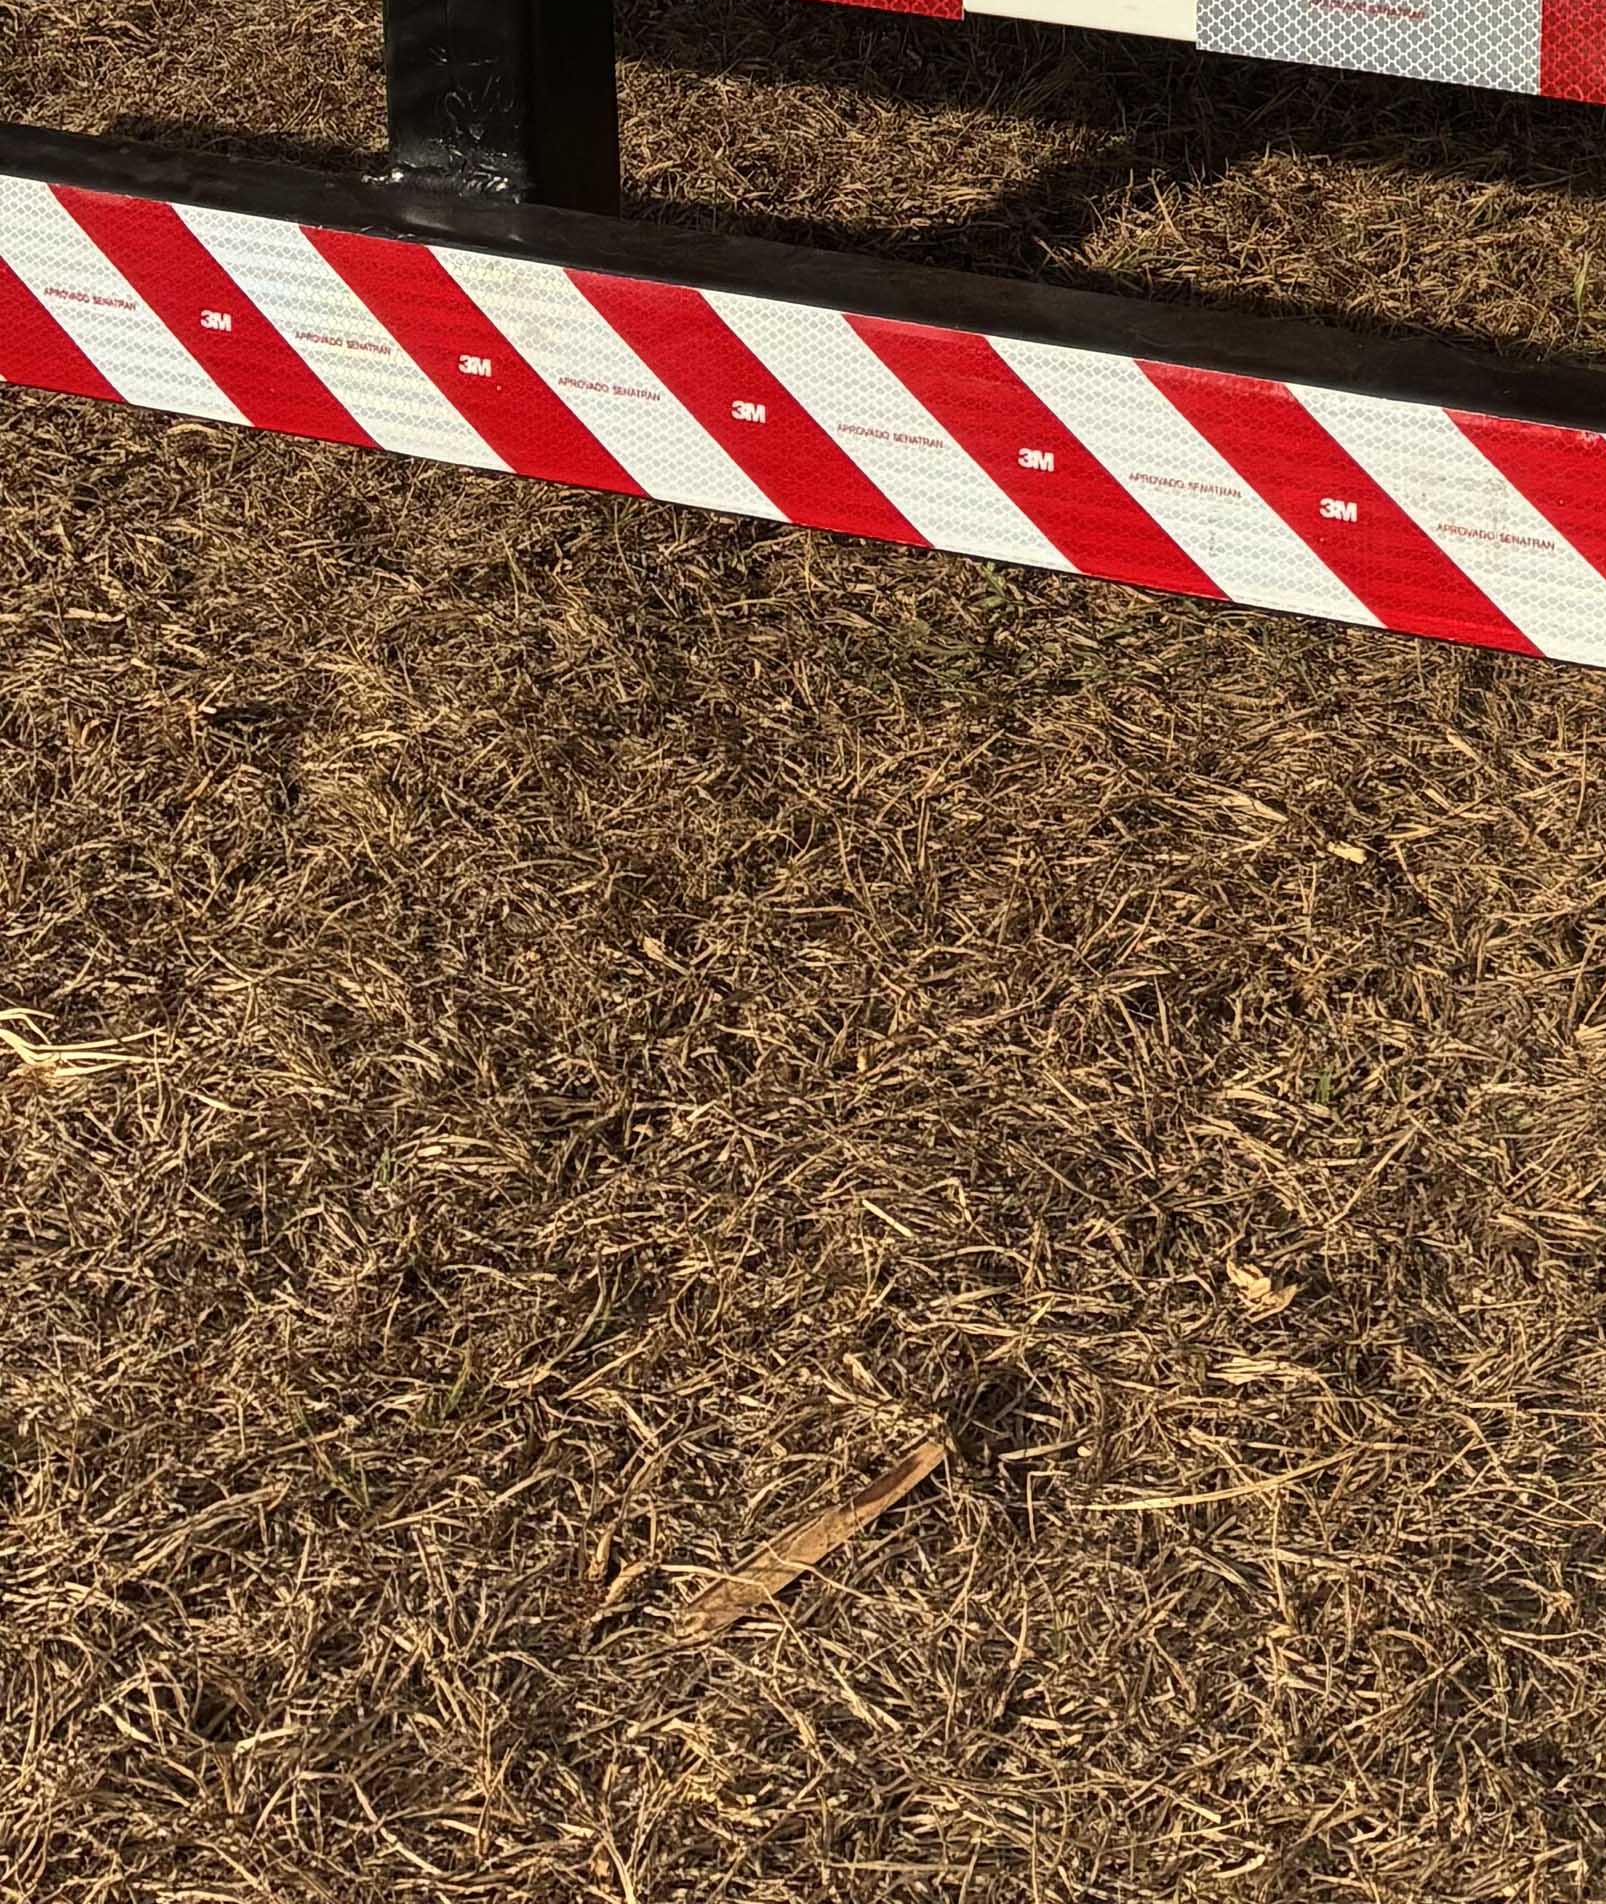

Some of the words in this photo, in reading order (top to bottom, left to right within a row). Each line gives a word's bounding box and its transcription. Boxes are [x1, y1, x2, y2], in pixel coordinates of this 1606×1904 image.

[200, 309, 232, 332] 3M
[458, 354, 492, 377] 3M
[731, 400, 766, 423] 3M
[837, 423, 890, 441] APROVADO
[1017, 448, 1055, 472] 3M
[1129, 472, 1184, 489] APROVADO
[1319, 498, 1357, 522] 3M
[1436, 523, 1496, 540] APROVADO
